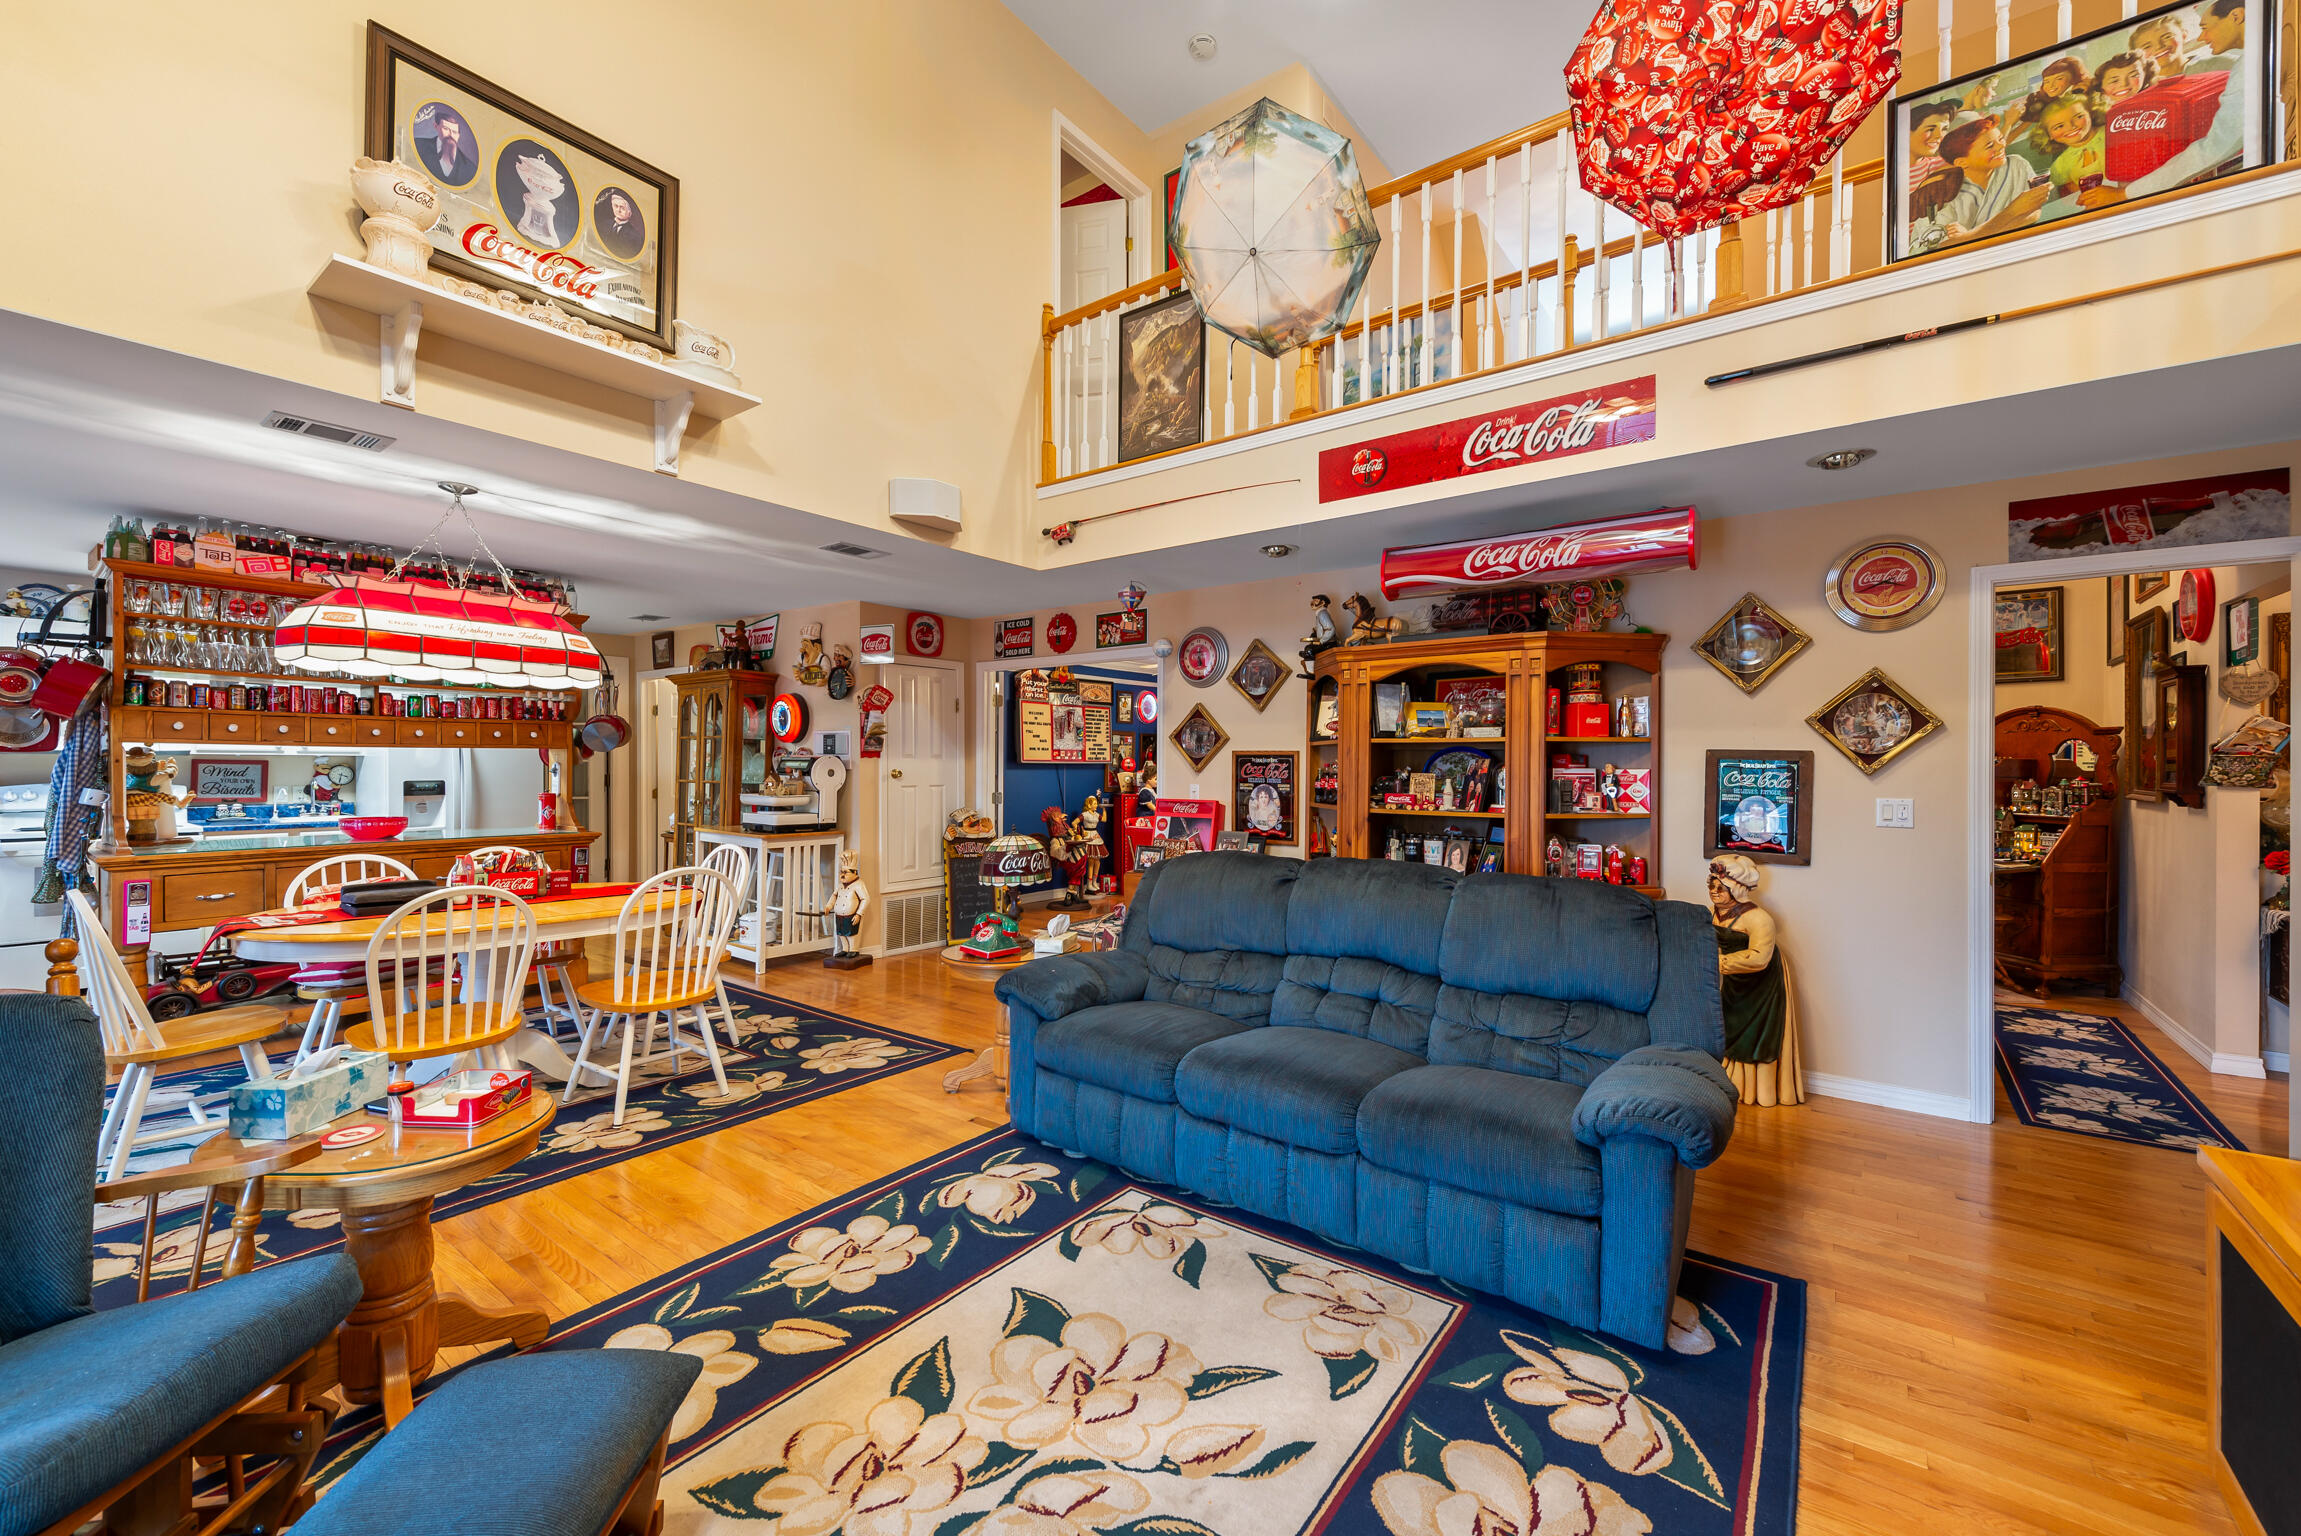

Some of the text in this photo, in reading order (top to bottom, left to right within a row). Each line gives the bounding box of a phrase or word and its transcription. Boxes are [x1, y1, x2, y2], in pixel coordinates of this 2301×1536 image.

[2110, 108, 2168, 133] Coca-Cola
[1751, 141, 1782, 152] Have a
[1750, 151, 1777, 163] Coke
[393, 181, 435, 210] Coca-Cola
[462, 223, 605, 300] Coca-Cola
[1462, 397, 1603, 467] Coca-Cola
[1351, 457, 1384, 476] Coca-Cola
[2119, 504, 2150, 542] Coca-Cola
[1463, 531, 1589, 577] Coca-Cola
[1858, 567, 1912, 587] Coca-Cola
[1016, 620, 1030, 628] COLD
[517, 631, 549, 644] Feeling
[863, 636, 889, 650] Coca-Cola
[1004, 630, 1032, 645] Coca-Cola
[1018, 647, 1031, 655] HERE
[1021, 678, 1033, 686] Put
[1033, 681, 1048, 690] your
[202, 765, 250, 778] Mind
[1241, 763, 1289, 778] Coca-Cola
[1724, 771, 1792, 788] Coca-Cola
[201, 781, 255, 796] Biscuits
[1173, 803, 1200, 814] Coca-Cola
[490, 876, 536, 891] Coca-Cola
